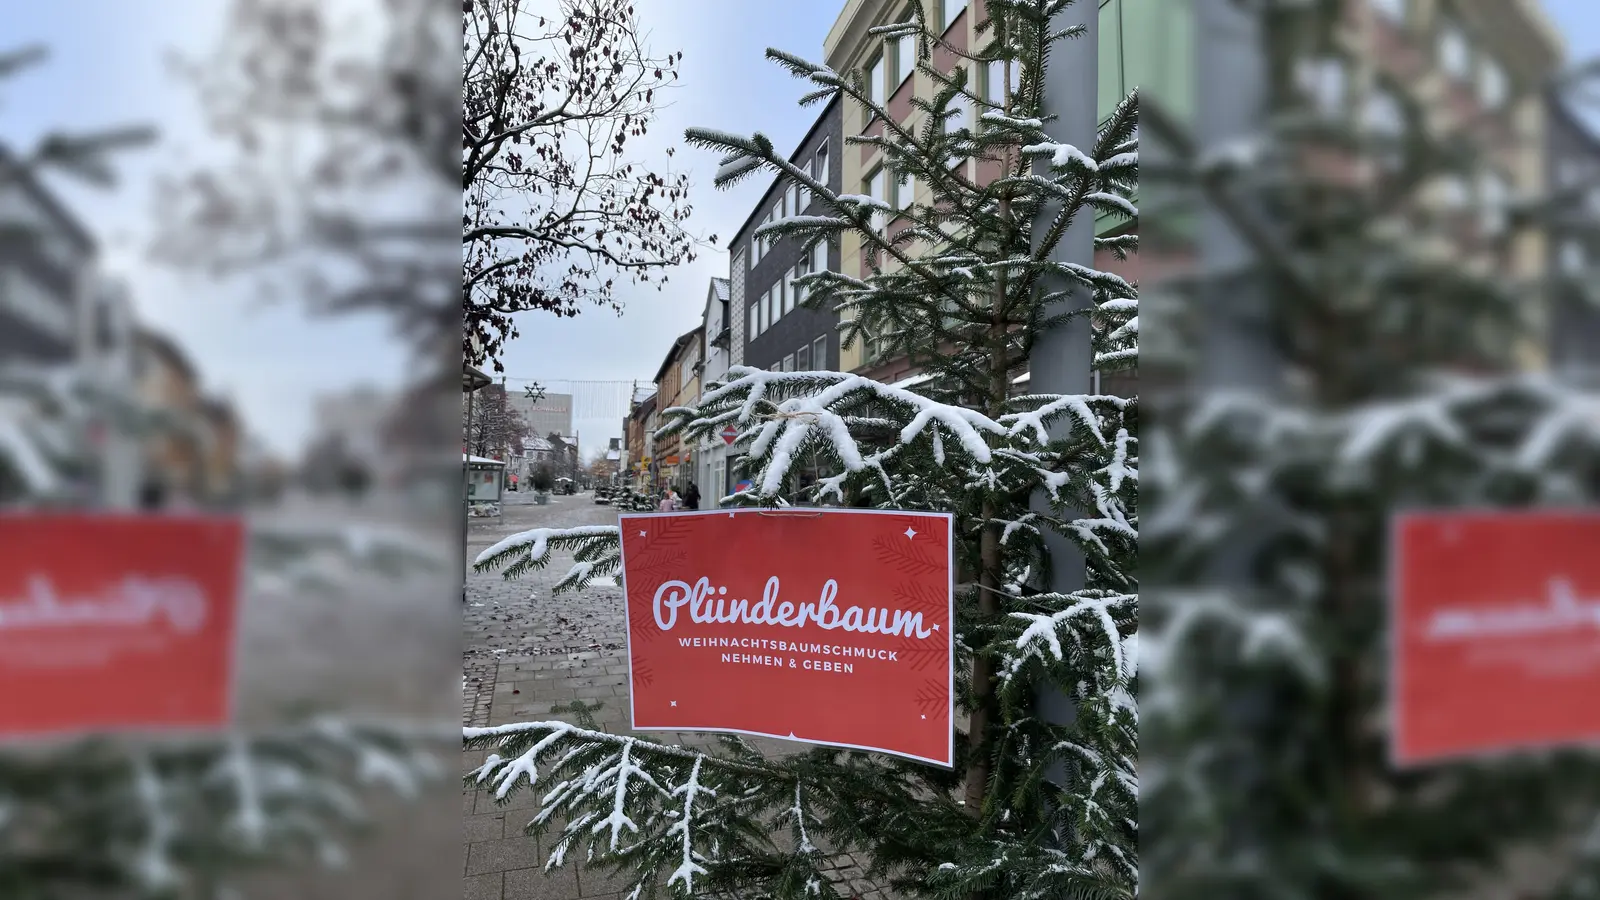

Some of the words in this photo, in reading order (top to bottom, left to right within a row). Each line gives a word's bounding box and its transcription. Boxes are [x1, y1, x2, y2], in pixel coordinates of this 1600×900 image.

[652, 575, 932, 640] Plünderbaum
[678, 637, 898, 662] WEIHNACHTSBAUMSCHMUCK
[721, 653, 783, 667] NEHMEN
[788, 658, 797, 669] &
[802, 659, 854, 674] GEBEN
